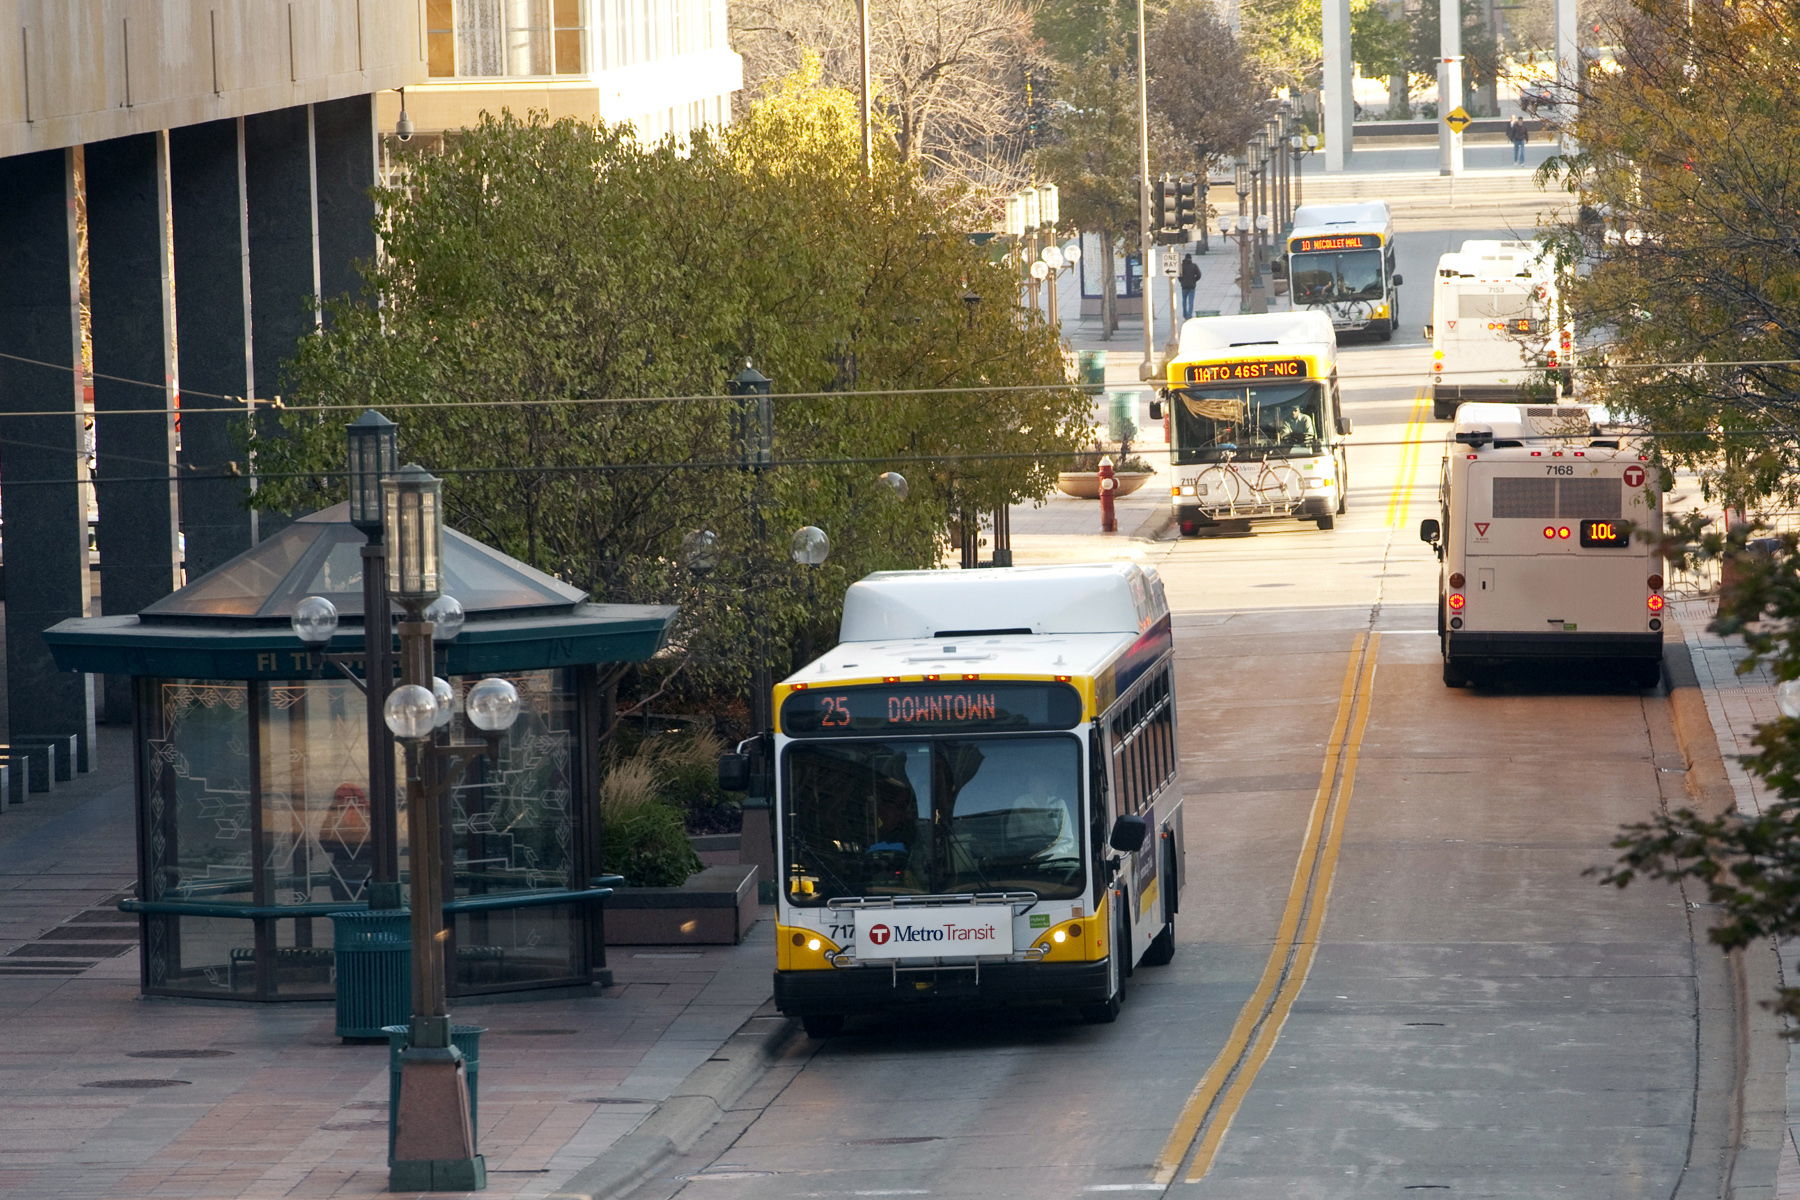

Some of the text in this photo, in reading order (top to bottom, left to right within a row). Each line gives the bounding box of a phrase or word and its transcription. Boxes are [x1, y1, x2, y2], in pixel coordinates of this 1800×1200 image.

[1301, 237, 1363, 251] 10 NICOLLET MALL
[1193, 361, 1298, 383] 11A TO 46ST-NIC
[1545, 465, 1574, 476] 7168
[1180, 477, 1197, 486] 7111
[820, 693, 996, 727] 25 DOWNTOWN
[893, 925, 943, 942] Metro
[943, 923, 996, 941] Transit
